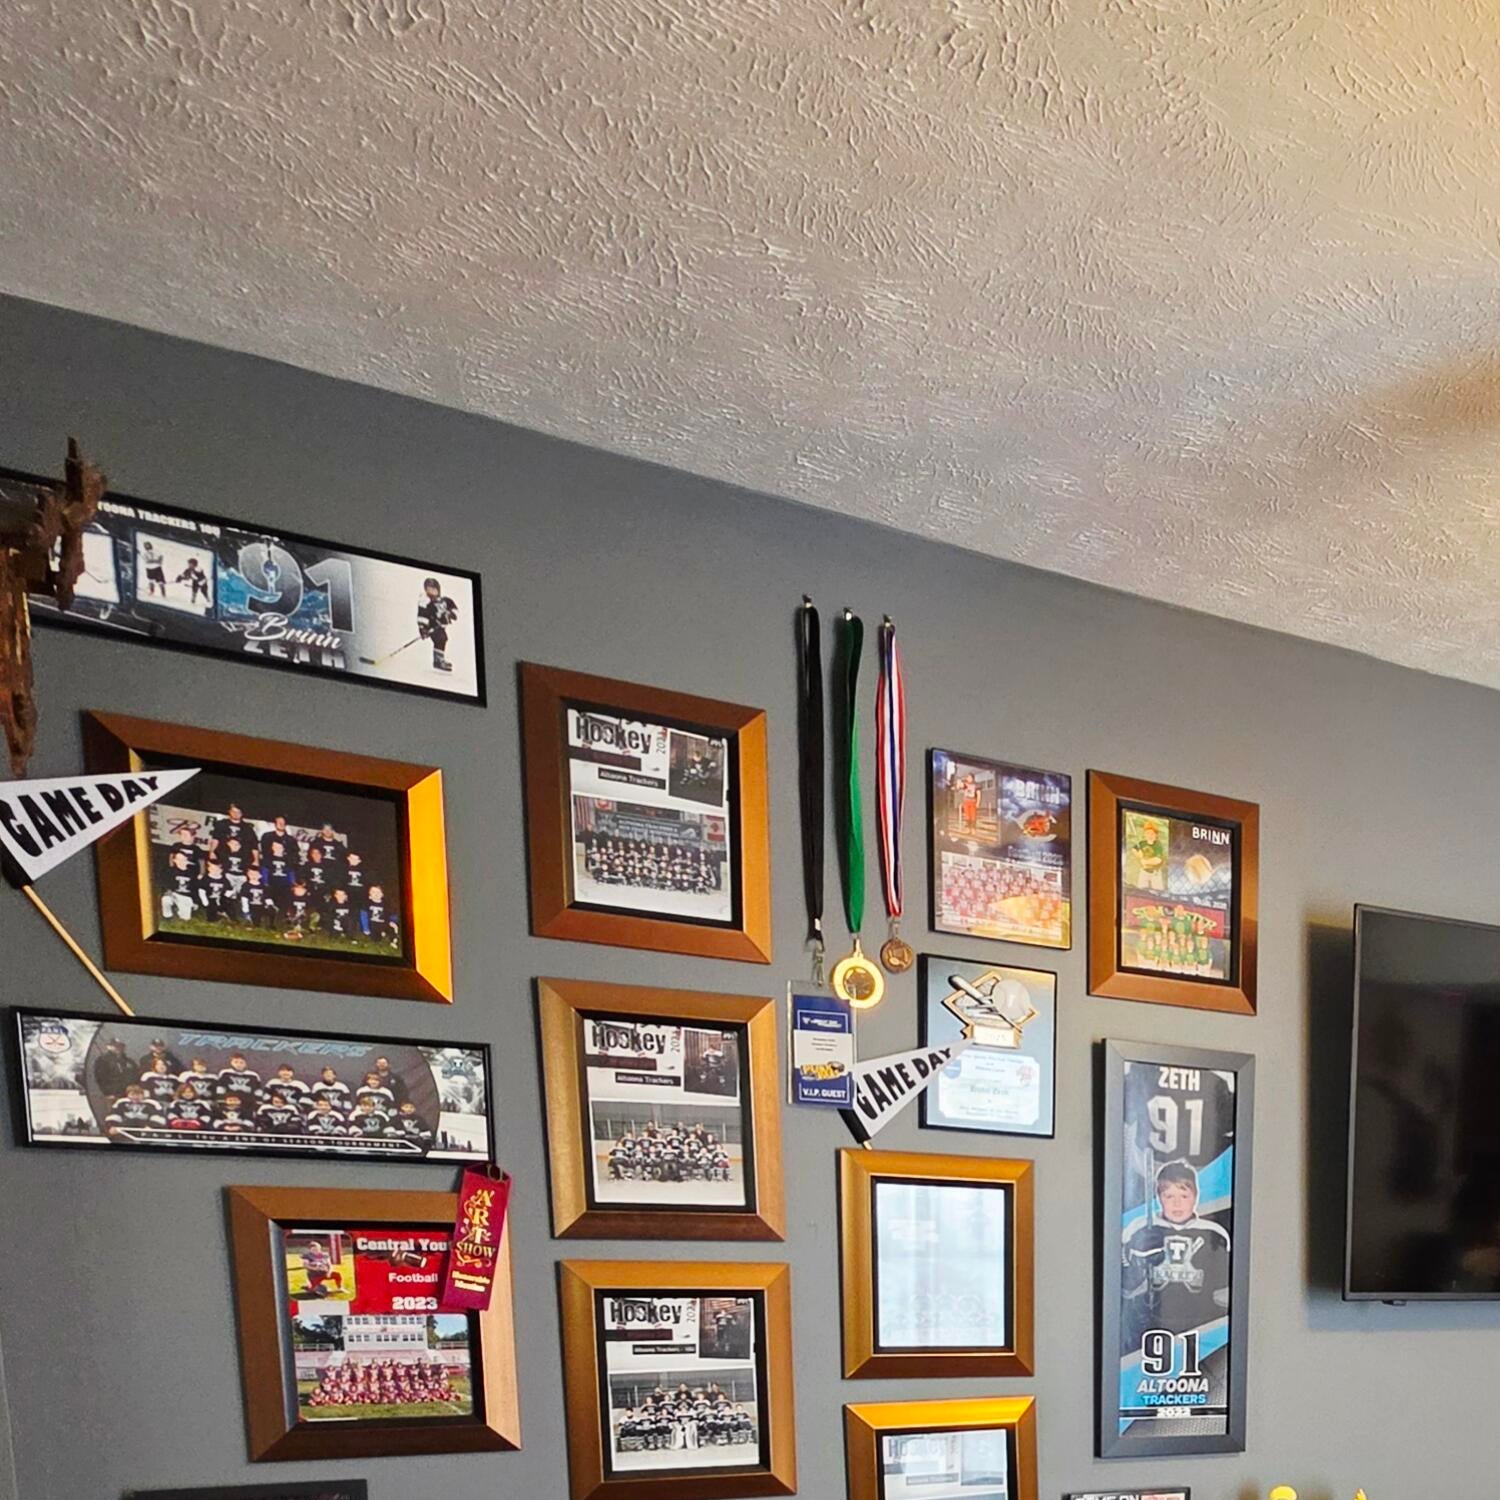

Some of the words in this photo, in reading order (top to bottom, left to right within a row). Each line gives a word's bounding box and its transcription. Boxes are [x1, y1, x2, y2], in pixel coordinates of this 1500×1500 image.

[238, 542, 355, 633] 91
[575, 714, 652, 754] Hockey
[0, 786, 102, 858] GAME
[94, 775, 161, 814] DAY
[1192, 826, 1230, 845] BRINN
[178, 1031, 374, 1059] TRACKERS
[591, 1023, 667, 1054] Hockey
[857, 1062, 917, 1120] GAME
[911, 1047, 952, 1080] DAY
[1157, 1066, 1201, 1092] ZETH
[821, 1088, 847, 1099] GUEST
[1146, 1095, 1204, 1156] 91
[356, 1237, 415, 1253] Central
[418, 1238, 451, 1253] You
[456, 1242, 496, 1259] SHOW
[388, 1272, 439, 1284] Football
[610, 1301, 682, 1324] Hockey
[1141, 1329, 1202, 1377] 91
[1136, 1377, 1209, 1393] ALTOONA
[1142, 1393, 1207, 1406] TRACKERS
